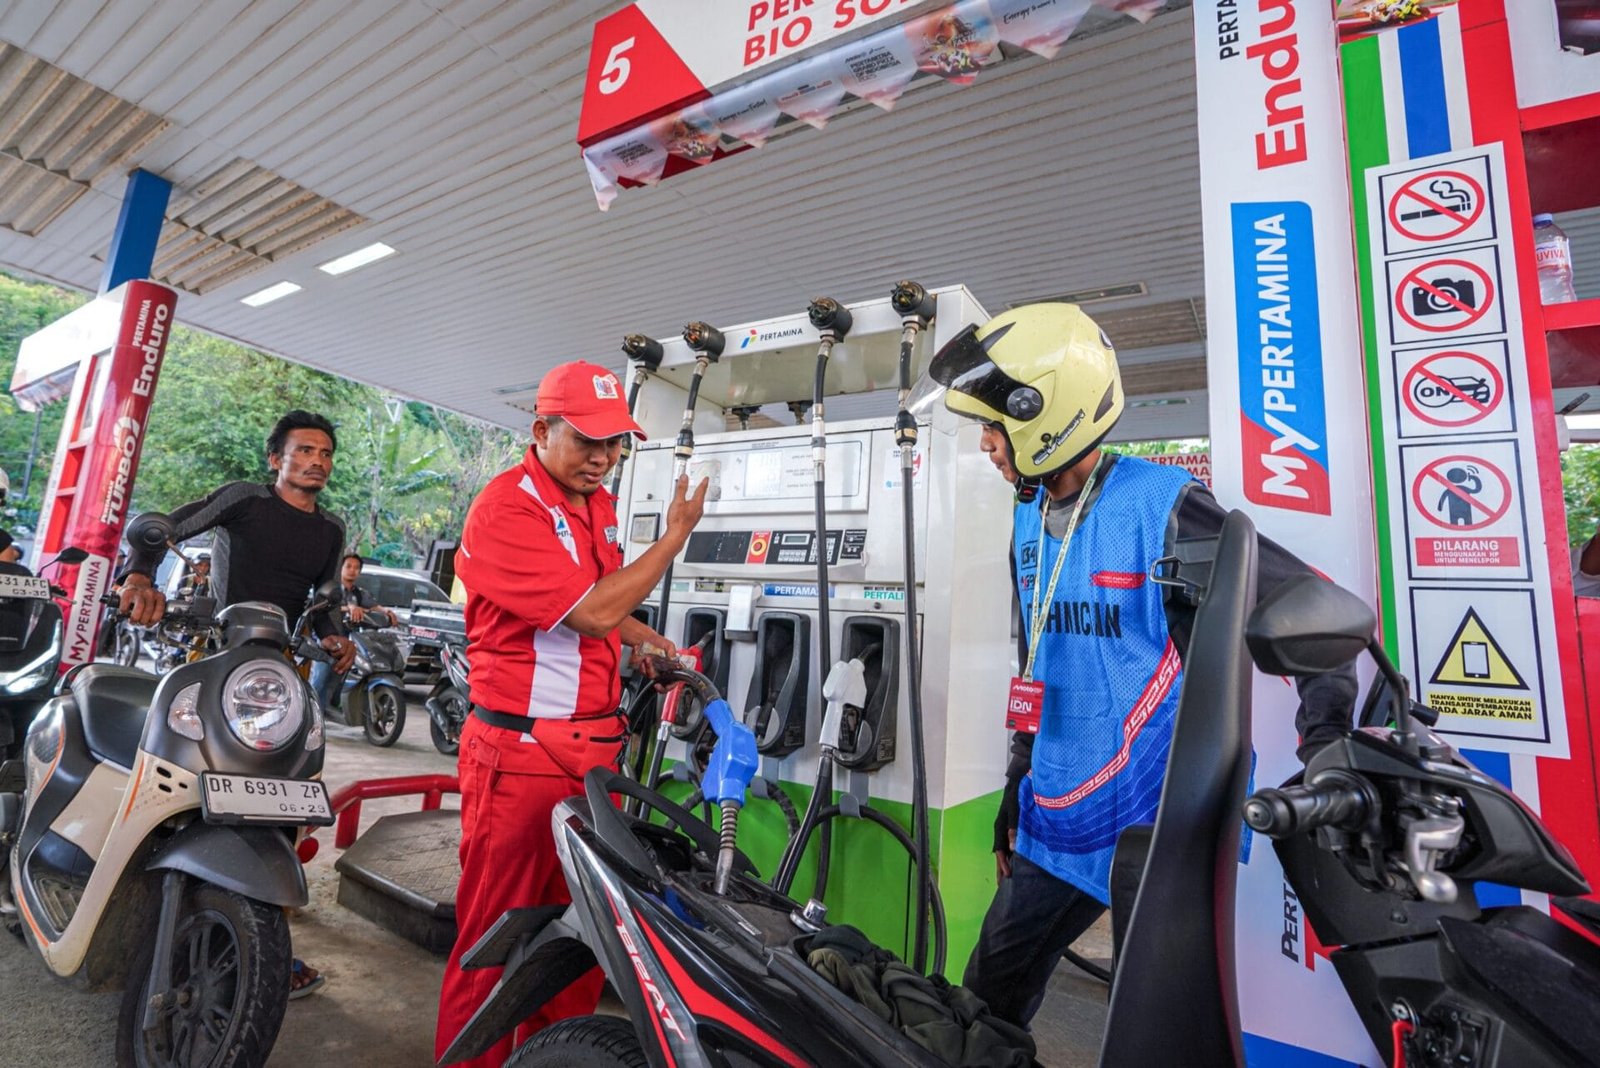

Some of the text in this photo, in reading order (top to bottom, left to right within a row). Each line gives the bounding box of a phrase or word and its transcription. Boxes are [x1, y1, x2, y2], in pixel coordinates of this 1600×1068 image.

[744, 16, 812, 66] BIO
[833, 0, 908, 29] SO
[599, 36, 635, 95] 5
[132, 299, 152, 348] PERTAMINA
[760, 328, 803, 341] PERTAMINA
[131, 304, 168, 397] Enduro
[1420, 386, 1451, 398] ON
[107, 435, 136, 525] TURBO
[1433, 540, 1499, 551] DILARANG
[774, 586, 819, 596] PERTAMA
[1010, 699, 1032, 712] IDN
[1431, 700, 1532, 712] TRANSAKSI PEMBAYARAN
[1483, 698, 1531, 706] MELAKUKAN
[1461, 708, 1495, 717] JARAK
[1498, 711, 1532, 720] AMAN
[209, 777, 320, 799] DR 6931 ZP
